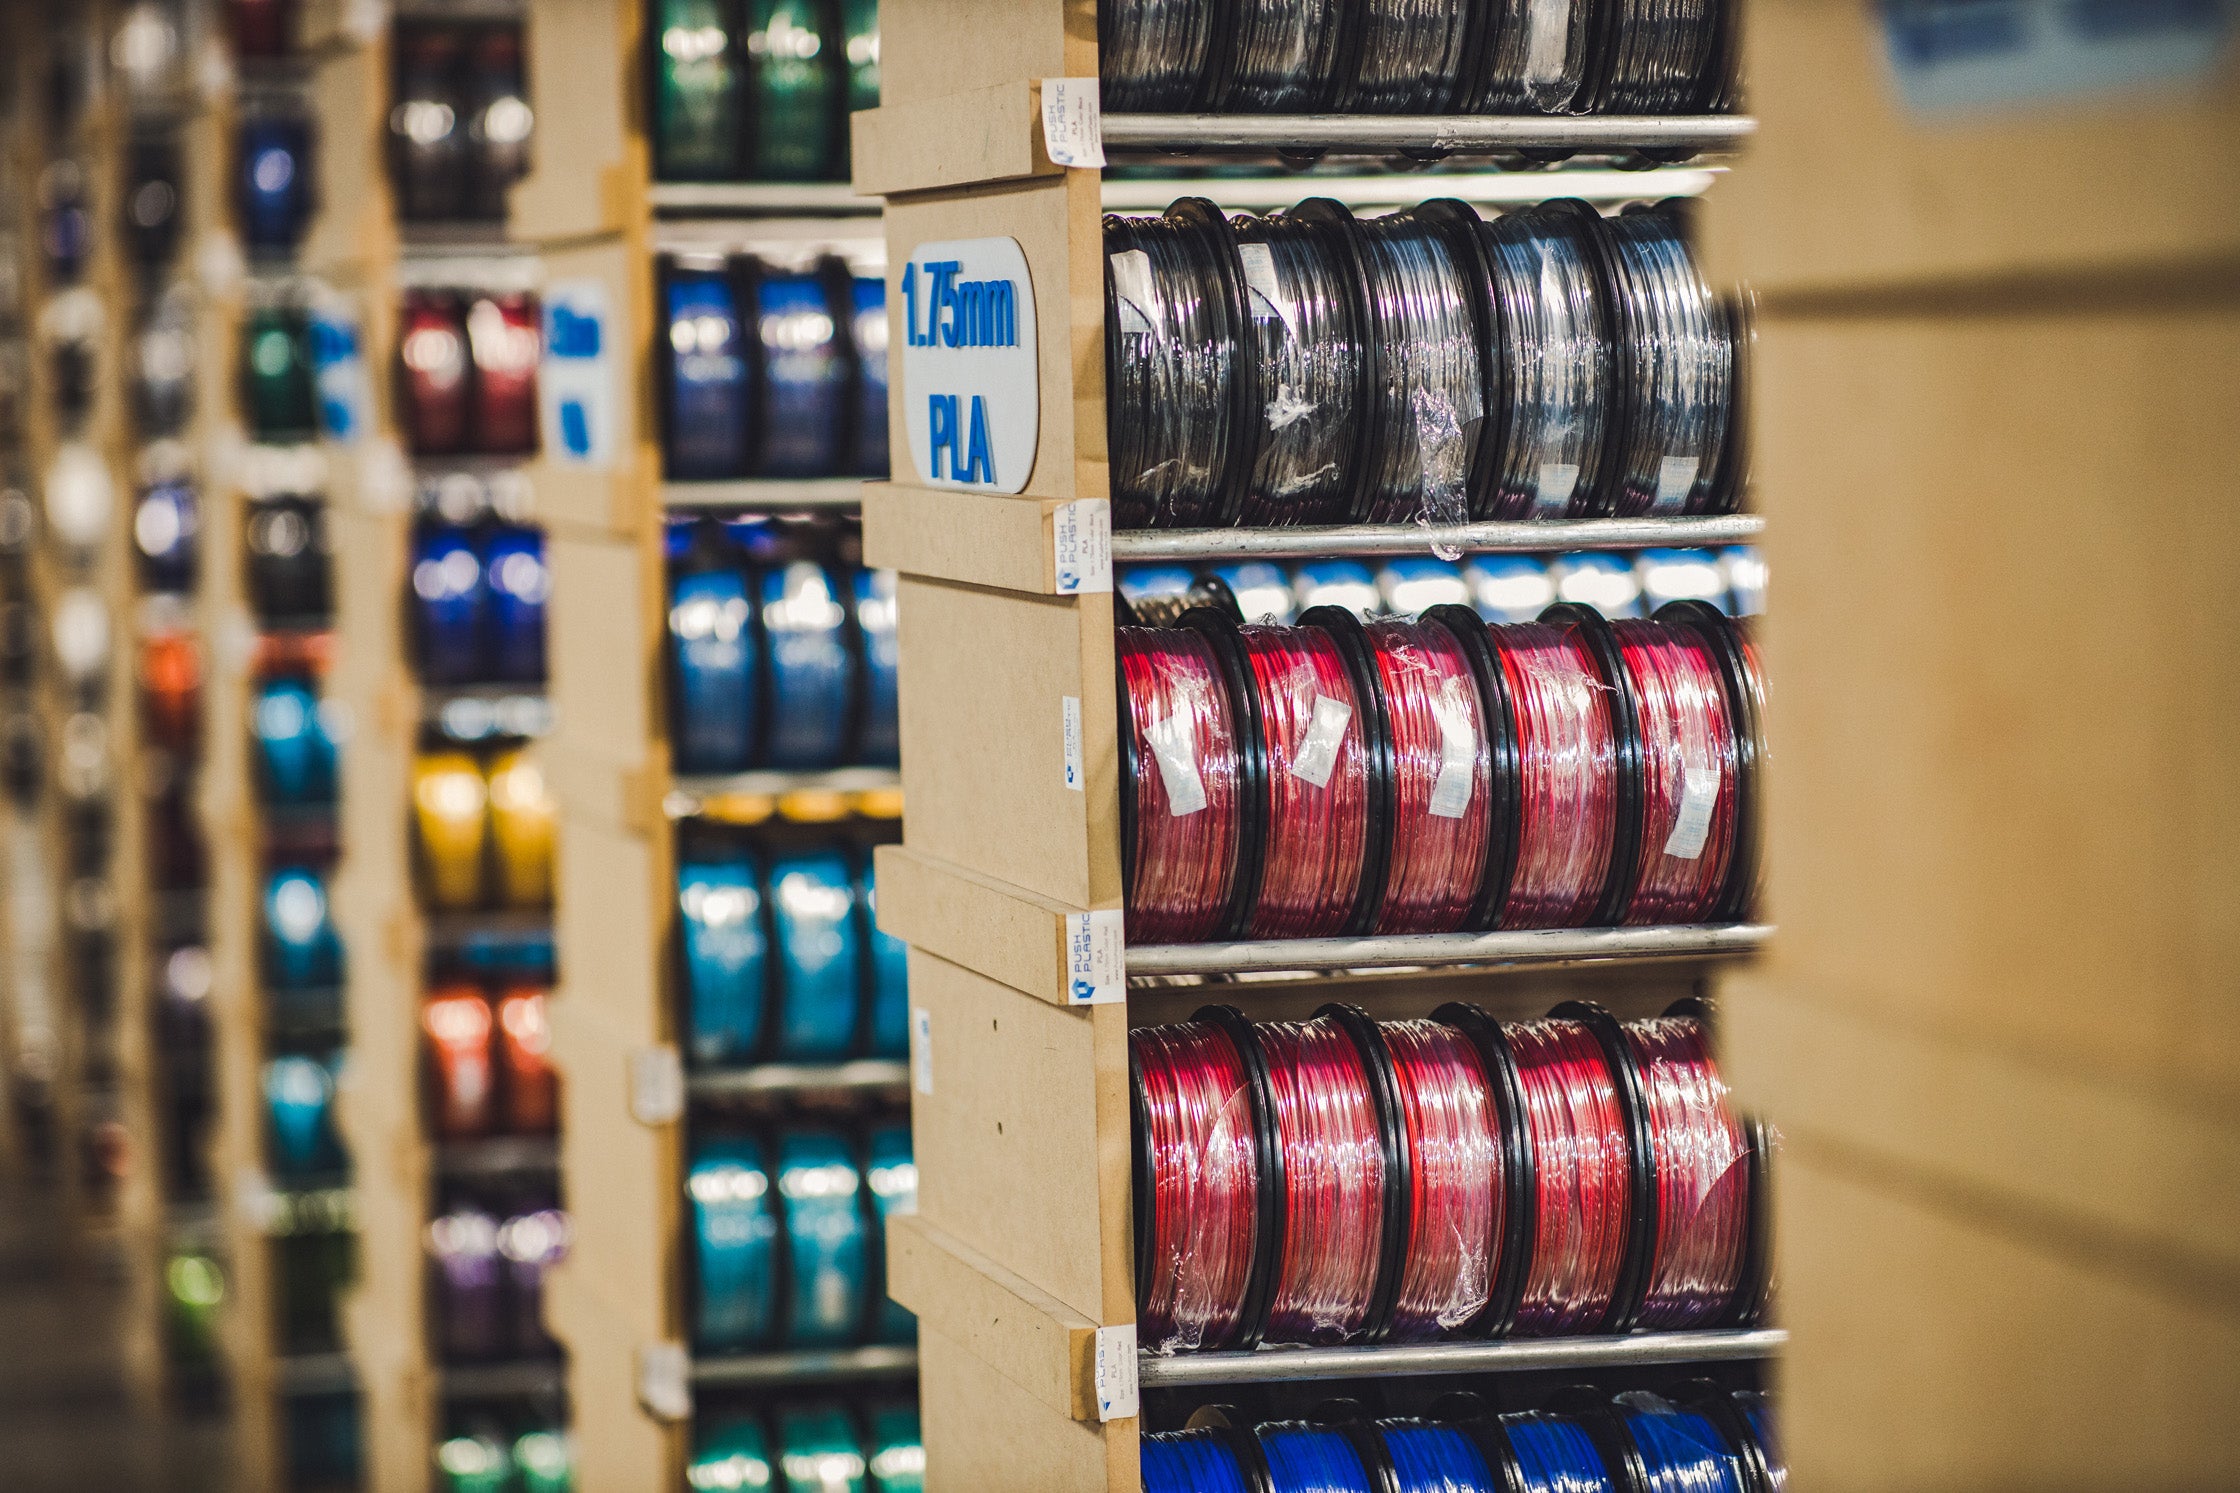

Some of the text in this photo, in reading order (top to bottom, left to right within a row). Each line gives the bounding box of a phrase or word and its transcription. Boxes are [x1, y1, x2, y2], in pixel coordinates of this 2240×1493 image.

[1048, 104, 1059, 142] PUSH
[1056, 84, 1068, 143] PLASTIC
[901, 260, 1020, 349] 1.75mm
[929, 394, 998, 484] PLA
[1059, 525, 1068, 563] PUSH
[1067, 503, 1077, 563] PLASTIC
[1073, 935, 1082, 973] PUSH
[1082, 914, 1092, 972] PLASTIC
[1098, 1329, 1106, 1388] PLAS
